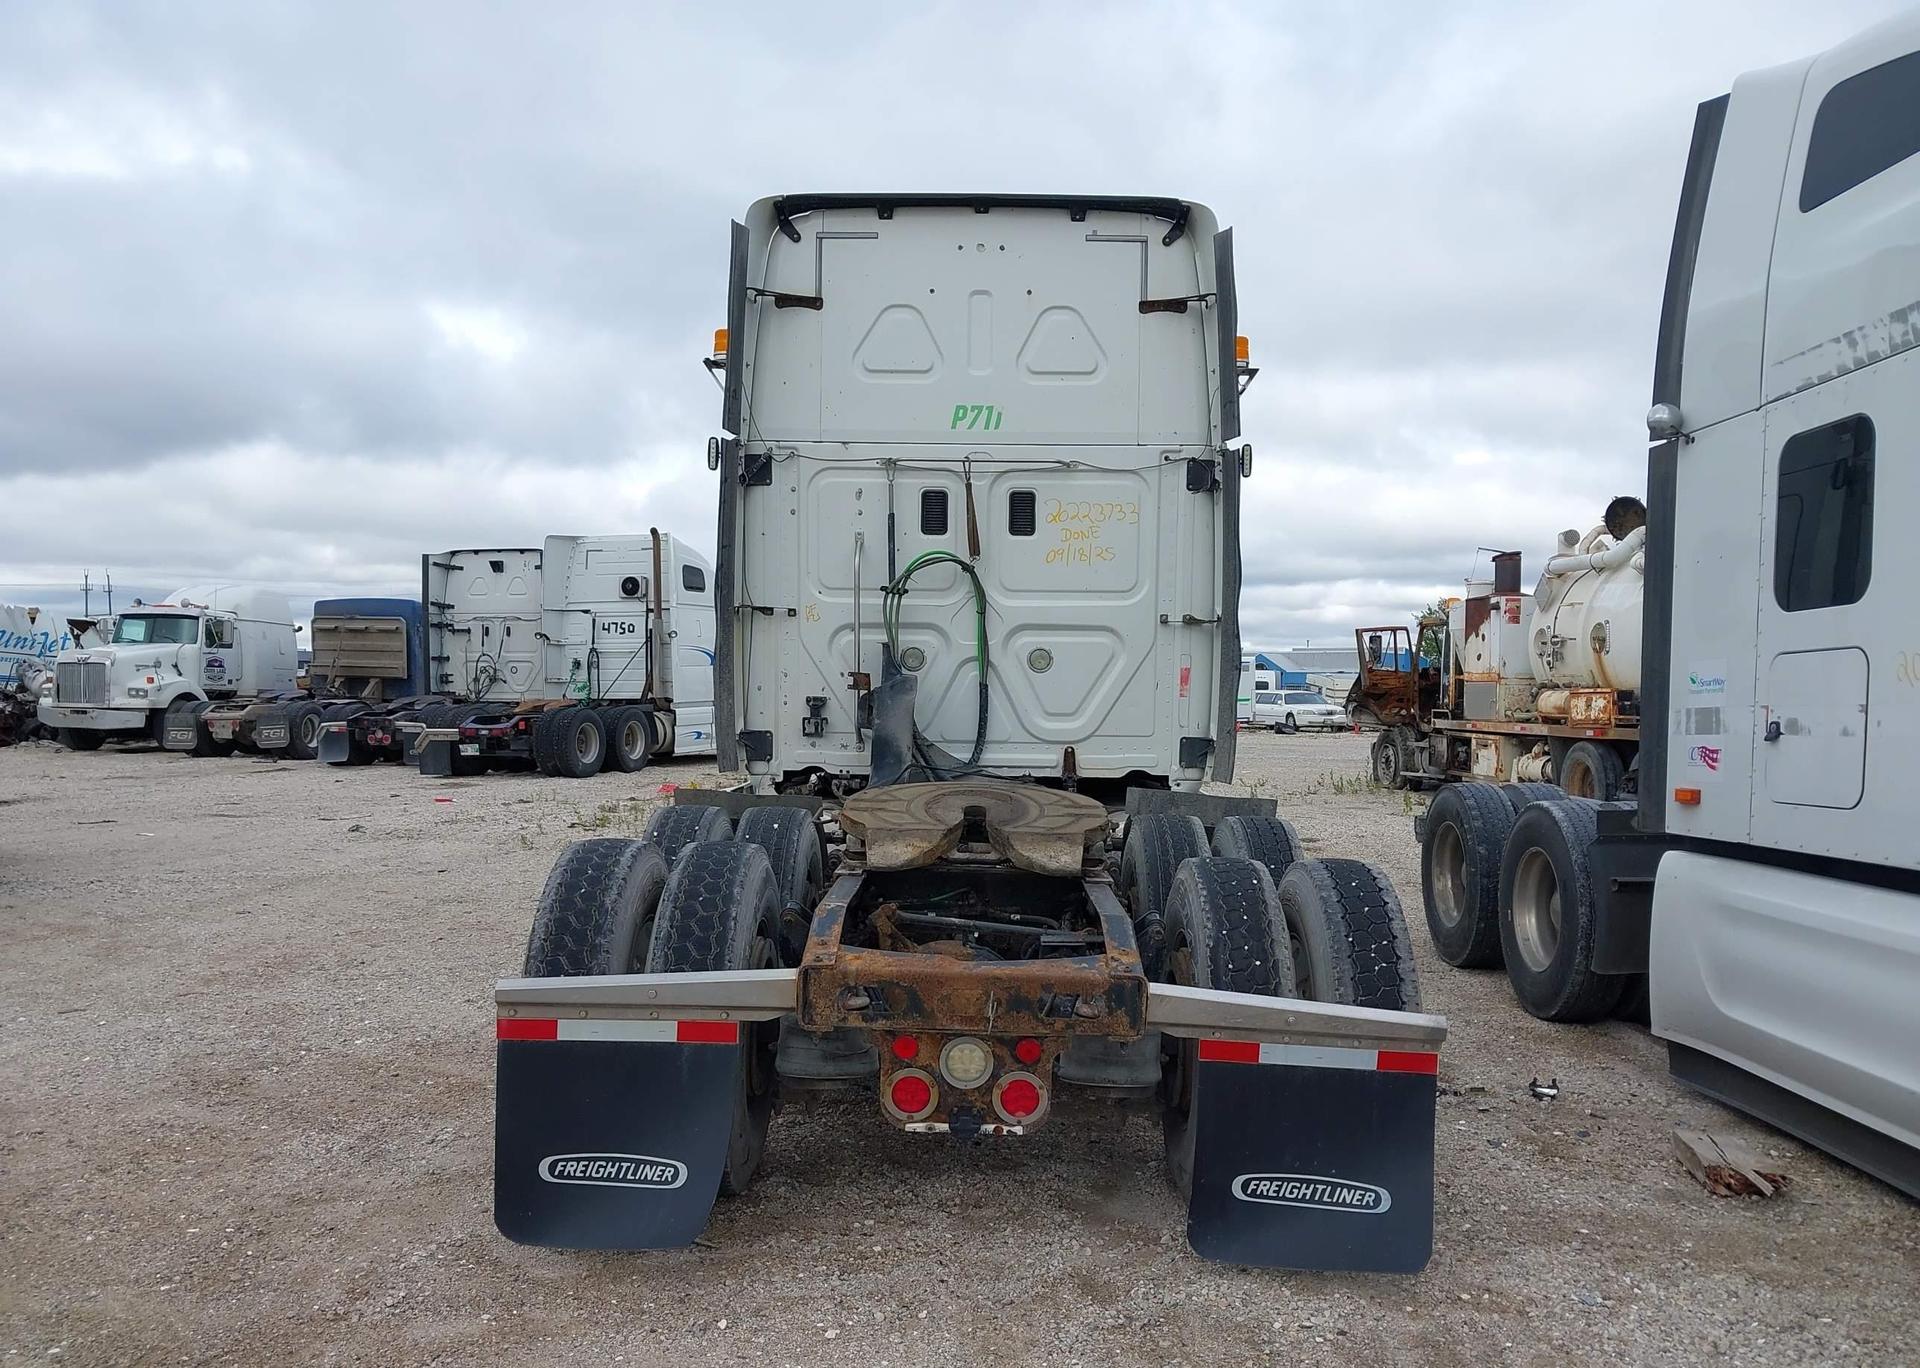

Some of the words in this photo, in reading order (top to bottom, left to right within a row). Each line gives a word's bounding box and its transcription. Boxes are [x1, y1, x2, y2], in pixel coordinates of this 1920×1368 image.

[1043, 498, 1140, 525] 20223733
[1060, 525, 1101, 543] DONE
[1045, 543, 1116, 568] 09/18/25
[601, 621, 636, 635] 4750
[168, 731, 193, 740] FGI
[260, 729, 285, 739] FGI
[554, 1160, 675, 1182] FREIGHTLINER
[1246, 1179, 1377, 1207] FREIGHTLINER
